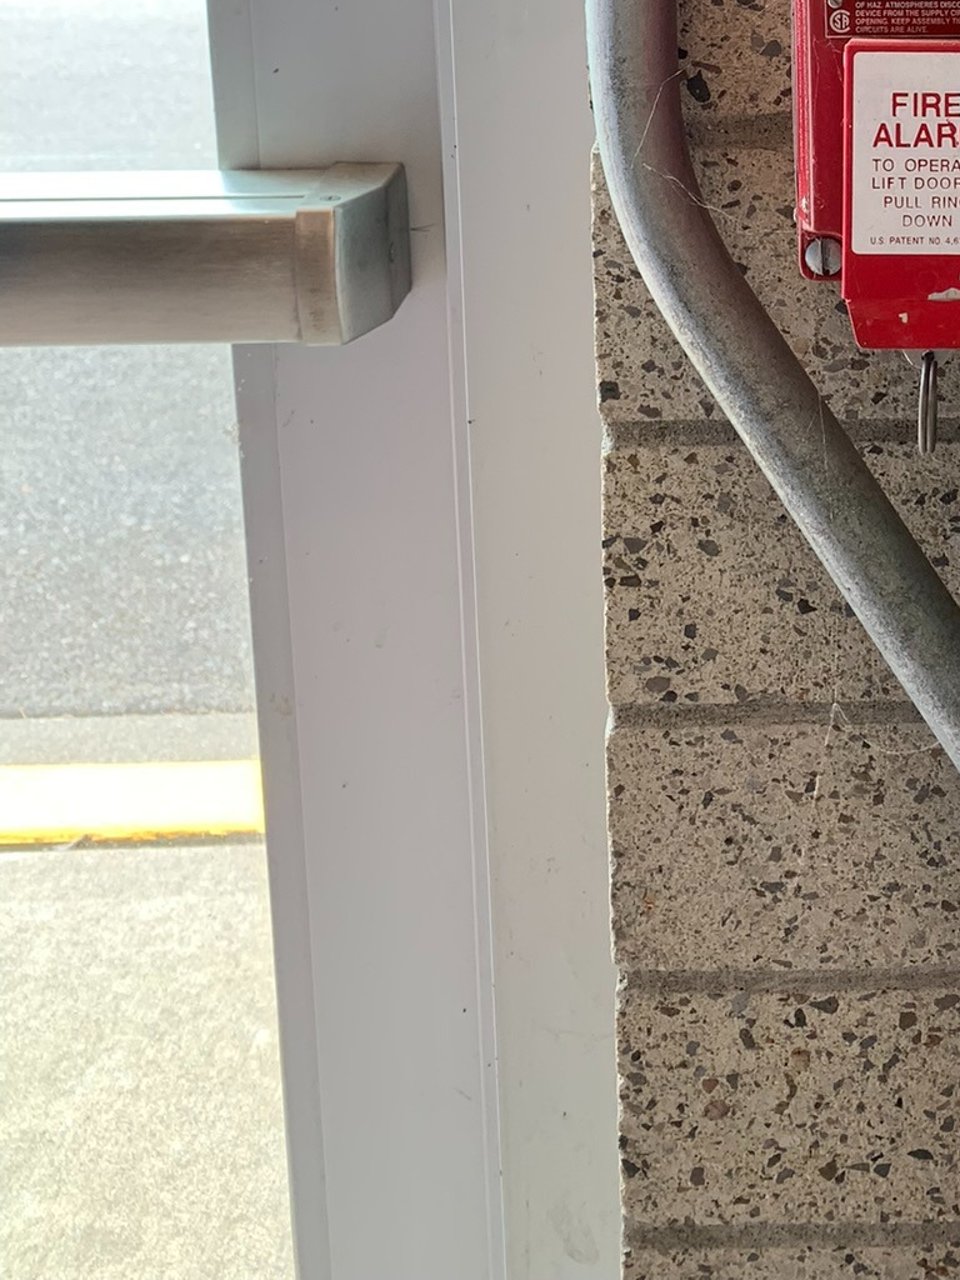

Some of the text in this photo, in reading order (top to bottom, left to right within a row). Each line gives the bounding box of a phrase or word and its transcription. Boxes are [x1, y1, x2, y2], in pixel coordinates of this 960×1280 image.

[912, 17, 950, 25] ASSEMBLY
[891, 93, 960, 117] FIRE
[873, 159, 894, 172] TO
[872, 177, 906, 190] LIFT
[884, 197, 921, 209] PULL
[902, 215, 952, 227] DOWN
[889, 237, 924, 245] PATENT
